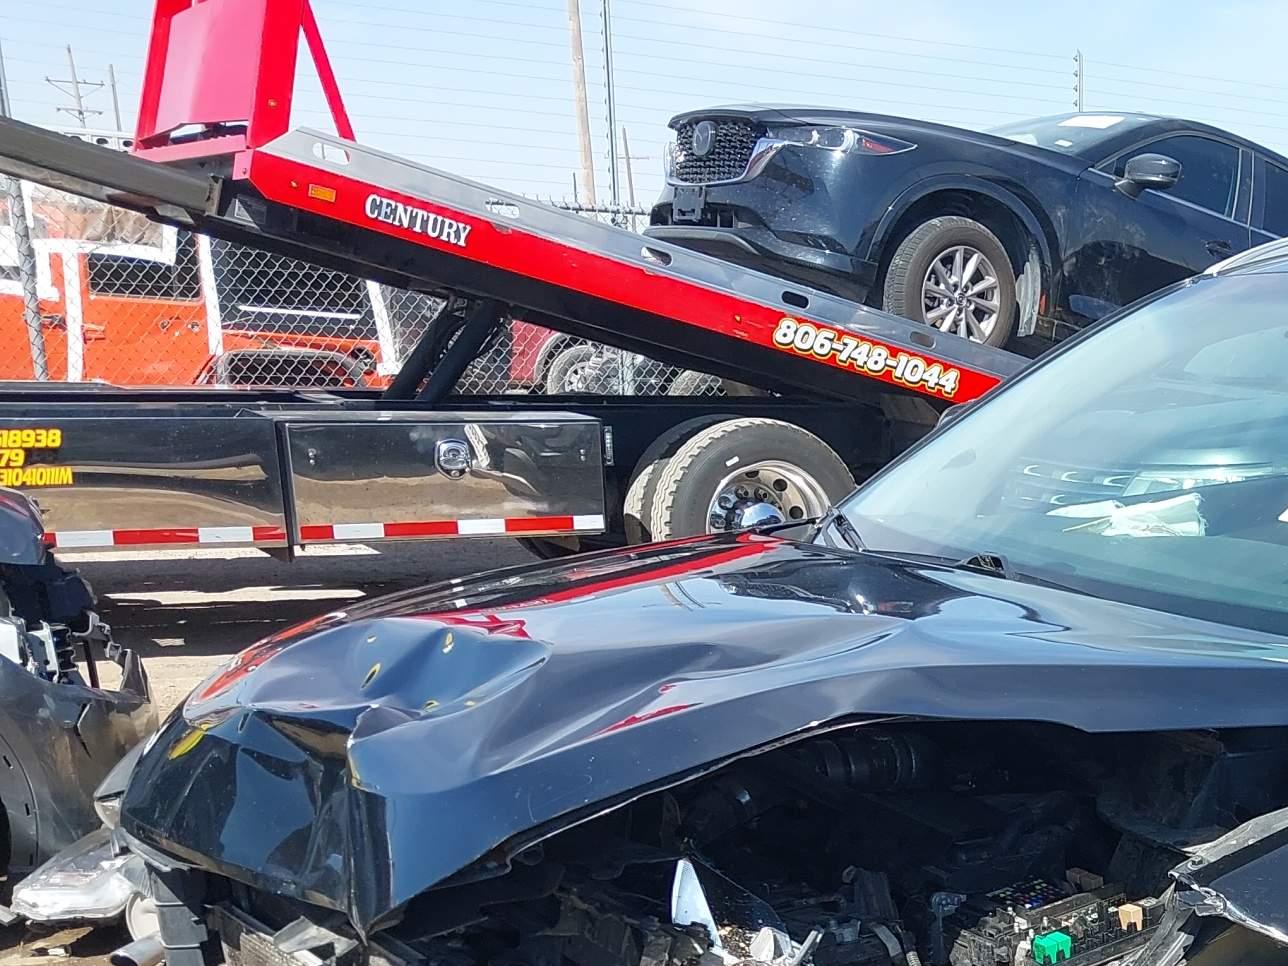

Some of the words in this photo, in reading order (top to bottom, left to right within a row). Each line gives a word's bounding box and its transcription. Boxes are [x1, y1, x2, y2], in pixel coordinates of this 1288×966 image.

[365, 193, 471, 247] CENTURY
[774, 319, 959, 395] 806-748-1044
[0, 428, 62, 449] 18938
